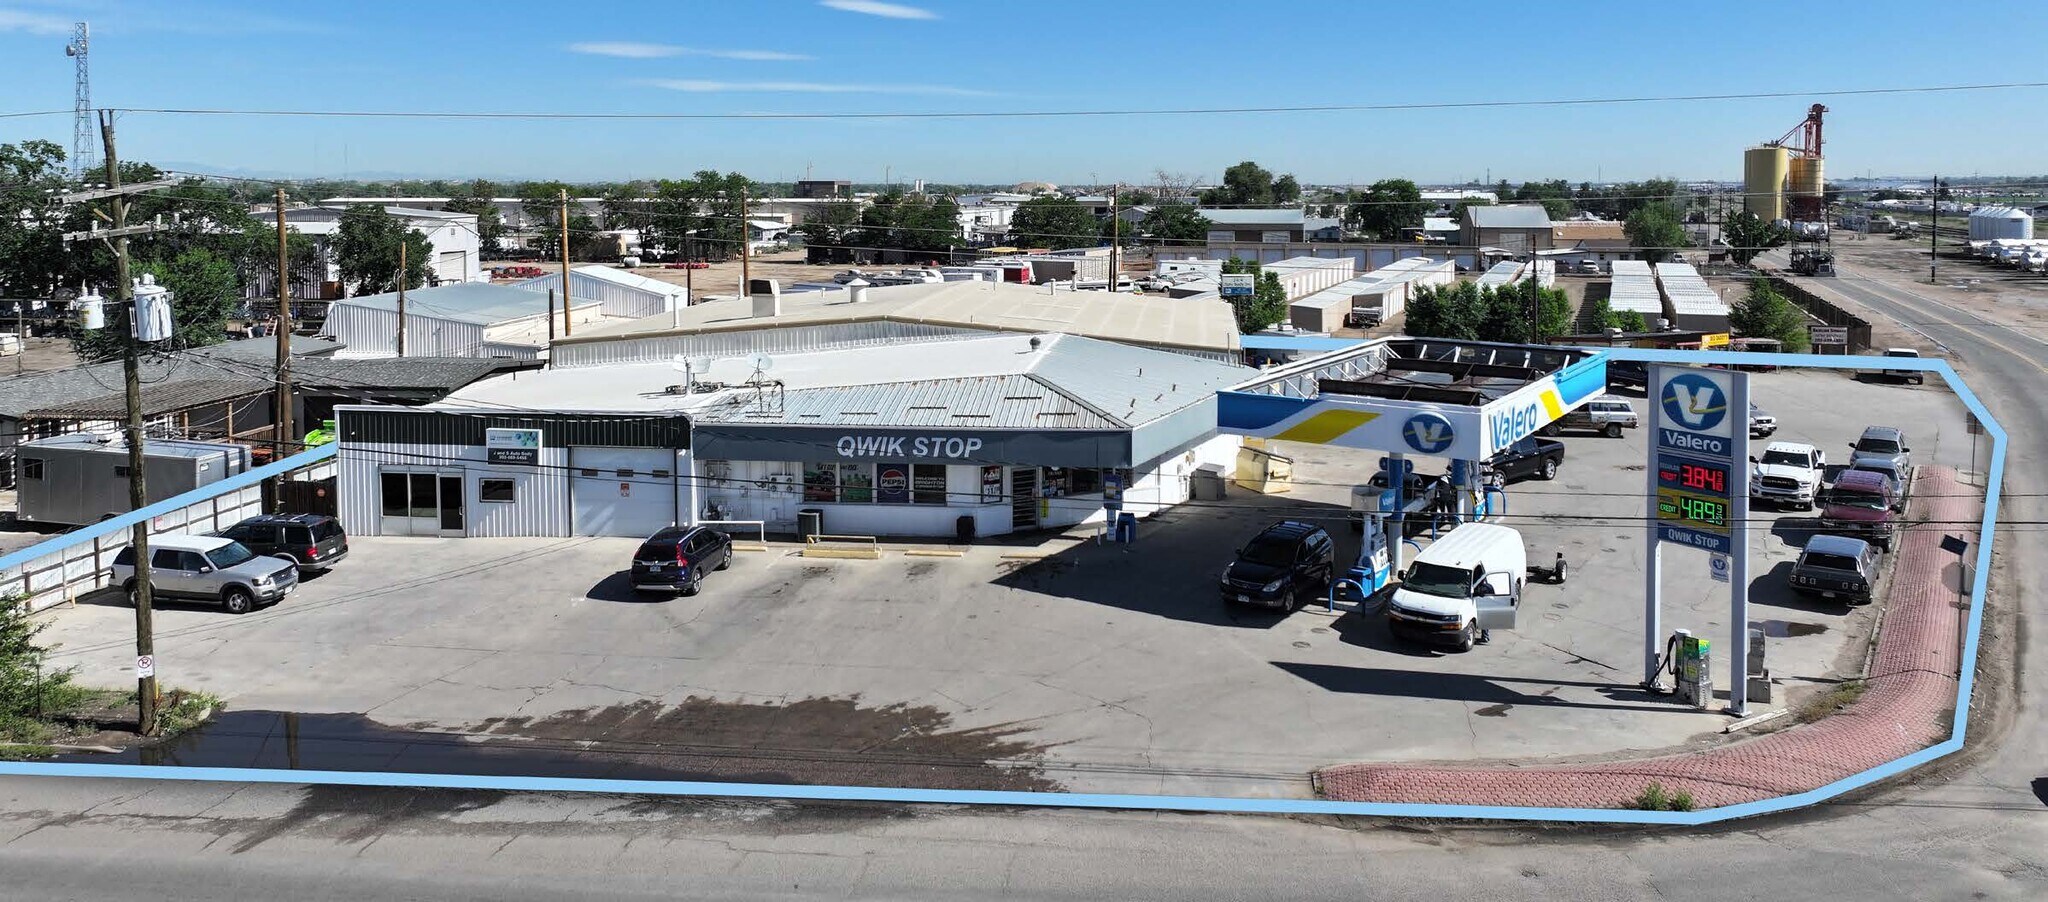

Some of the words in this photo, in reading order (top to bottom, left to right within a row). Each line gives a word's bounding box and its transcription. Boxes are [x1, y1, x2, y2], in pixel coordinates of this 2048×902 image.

[1492, 402, 1537, 450] Valero
[836, 435, 905, 458] QWIK
[912, 437, 982, 458] STOP
[1665, 431, 1722, 452] Valero
[1660, 471, 1677, 480] CREDIT
[1660, 503, 1676, 513] CREDIT
[1668, 528, 1693, 545] QWIK
[1695, 534, 1719, 549] STOP
